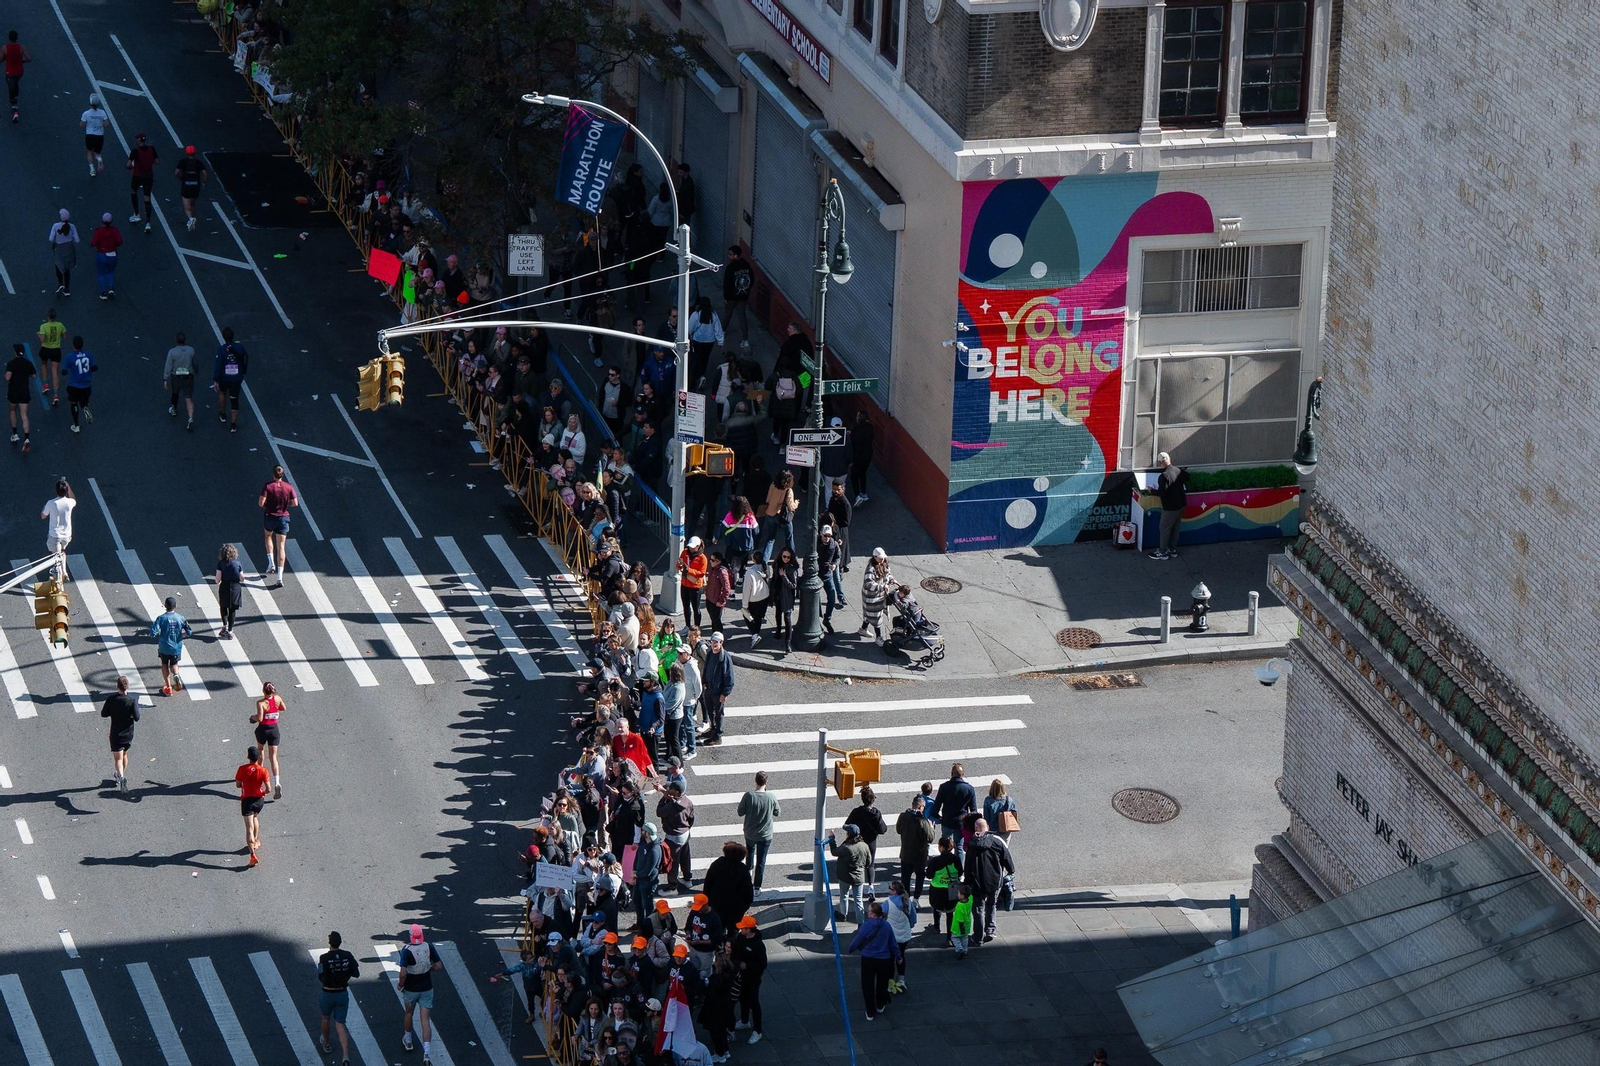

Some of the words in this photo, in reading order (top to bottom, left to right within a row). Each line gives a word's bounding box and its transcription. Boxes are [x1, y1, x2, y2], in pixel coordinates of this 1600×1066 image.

[791, 25, 819, 72] SCHOOL
[567, 120, 605, 205] MARATHON
[585, 158, 613, 213] ROUTE
[1459, 180, 1531, 253] BEETHOVEN
[1459, 231, 1523, 297] SCHUBERT
[998, 295, 1084, 343] YOU
[75, 357, 90, 375] 13
[967, 340, 1120, 385] BELONG
[830, 382, 840, 393] St
[842, 381, 862, 392] Felix
[988, 386, 1091, 426] HERE
[798, 434, 814, 442] ONE
[820, 433, 837, 441] WAY
[1336, 771, 1370, 822] PETER
[1375, 813, 1394, 845] JAY
